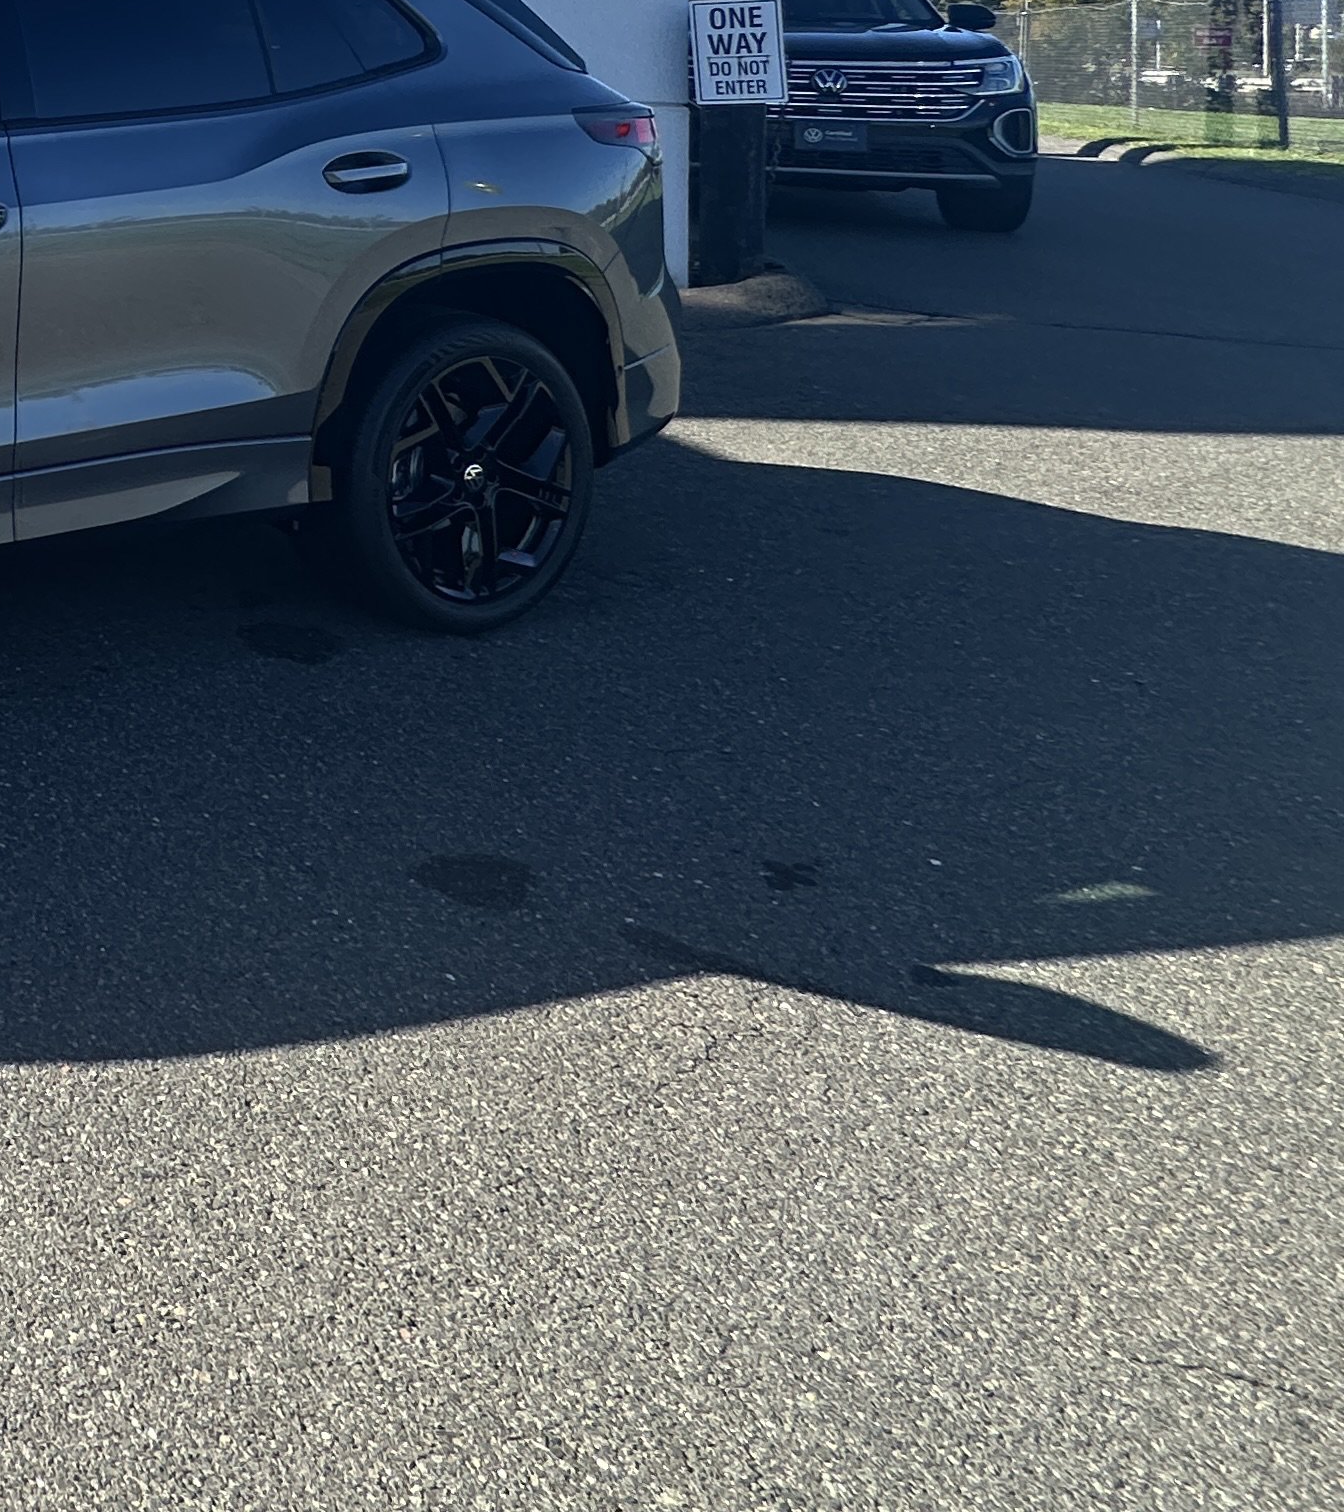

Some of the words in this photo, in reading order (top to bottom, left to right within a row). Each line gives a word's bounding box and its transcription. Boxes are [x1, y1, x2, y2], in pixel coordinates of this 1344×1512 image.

[708, 6, 764, 30] ONE
[707, 31, 768, 56] WAY
[709, 61, 732, 77] DO
[737, 59, 770, 76] NOT
[715, 79, 768, 96] ENTER
[814, 69, 847, 94] VW
